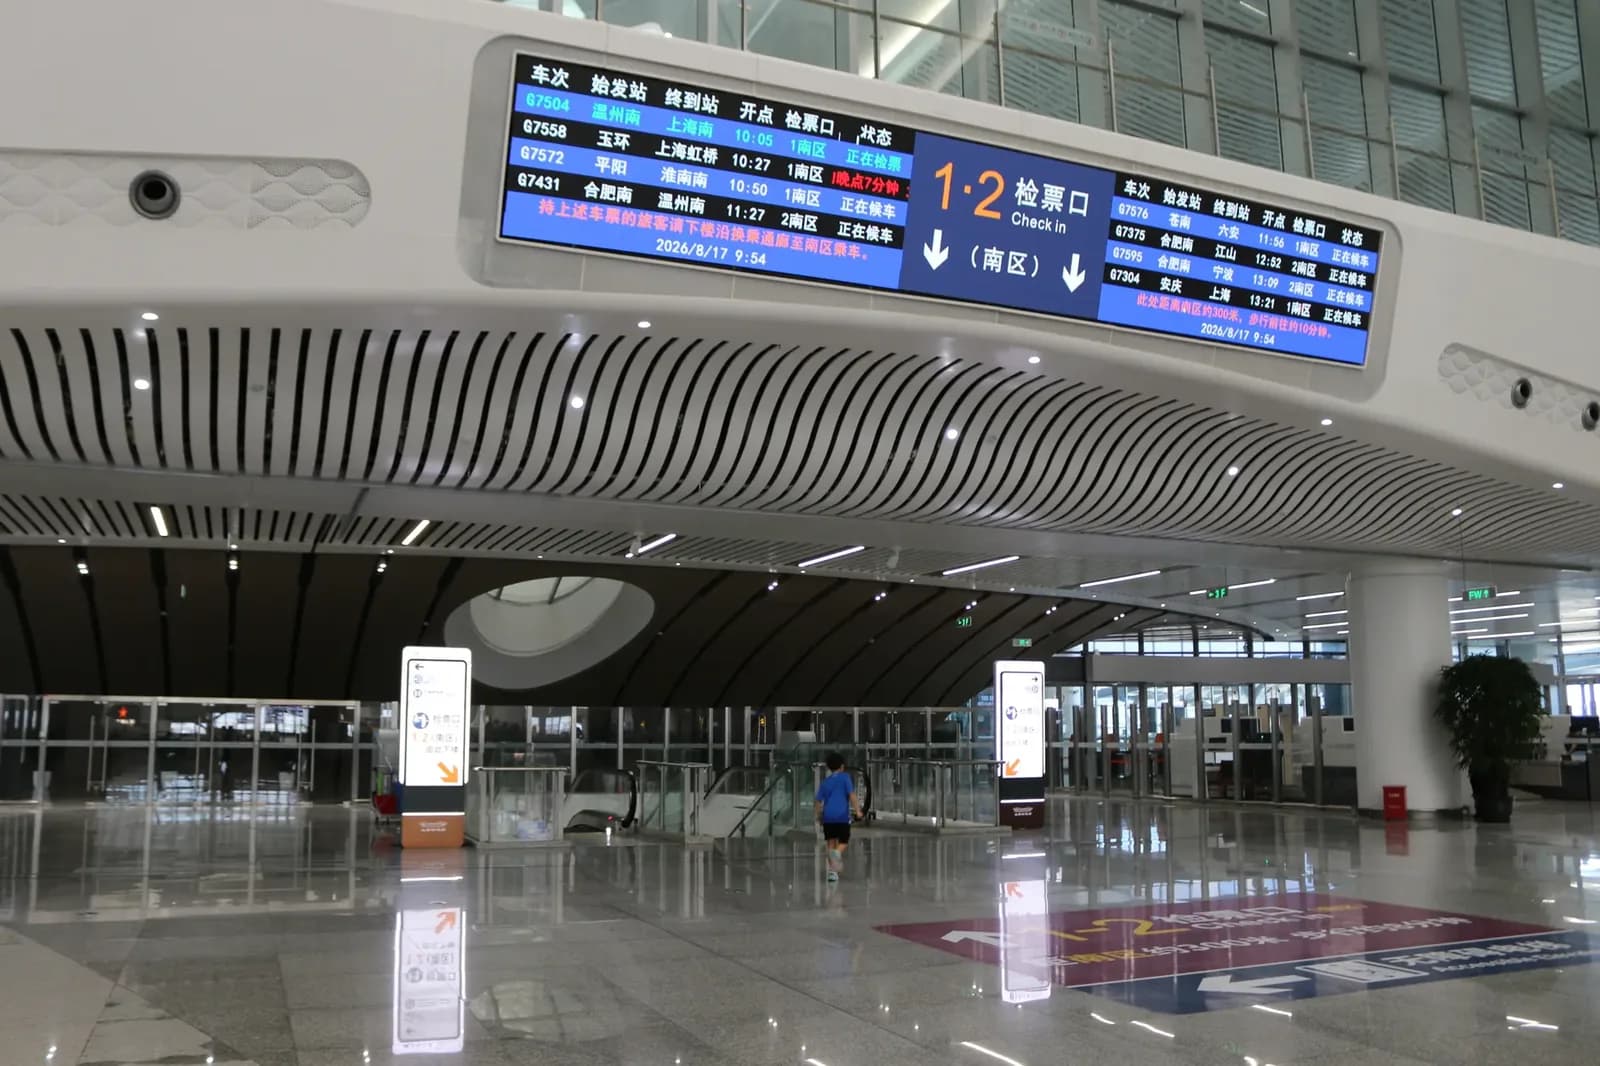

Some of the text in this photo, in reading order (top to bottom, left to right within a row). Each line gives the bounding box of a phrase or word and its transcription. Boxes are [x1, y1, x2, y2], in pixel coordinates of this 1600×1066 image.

[526, 92, 902, 172] G7504 温州南 上海南 10:05 1南区 正在检票
[531, 64, 892, 146] 车次 始发站 终到站 开点 检票口 状态
[520, 146, 896, 220] G7572 平阳 淮南南 10:50 1南区 正在候车
[523, 119, 568, 139] G7558
[597, 130, 630, 150] 玉环
[655, 140, 719, 165] 上海虹桥
[732, 153, 770, 172] 10:27
[788, 163, 824, 184] 1南区
[518, 172, 894, 244] G7431 合肥南 温州南 11:27 2南区 正在候车
[1011, 212, 1066, 234] Check in
[1015, 177, 1089, 216] 检票口
[1124, 179, 1363, 246] 车次 始发站 终到站 开点 检票口 状态
[656, 239, 766, 265] 2026/8/17 9:54
[1115, 225, 1366, 288] G7375 合肥南 江山 12:52 2南区 正在候车
[1118, 203, 1369, 268] G7576 苍南 六安 11:56 1南区 正在候车
[1110, 268, 1361, 327] G7304 安庆 上海 13:21 1南区 正在候车
[1113, 247, 1364, 307] G7595 合肥南 宁波 13:09 2南区 正在候车
[1201, 322, 1275, 344] 2026/8/17 9:54
